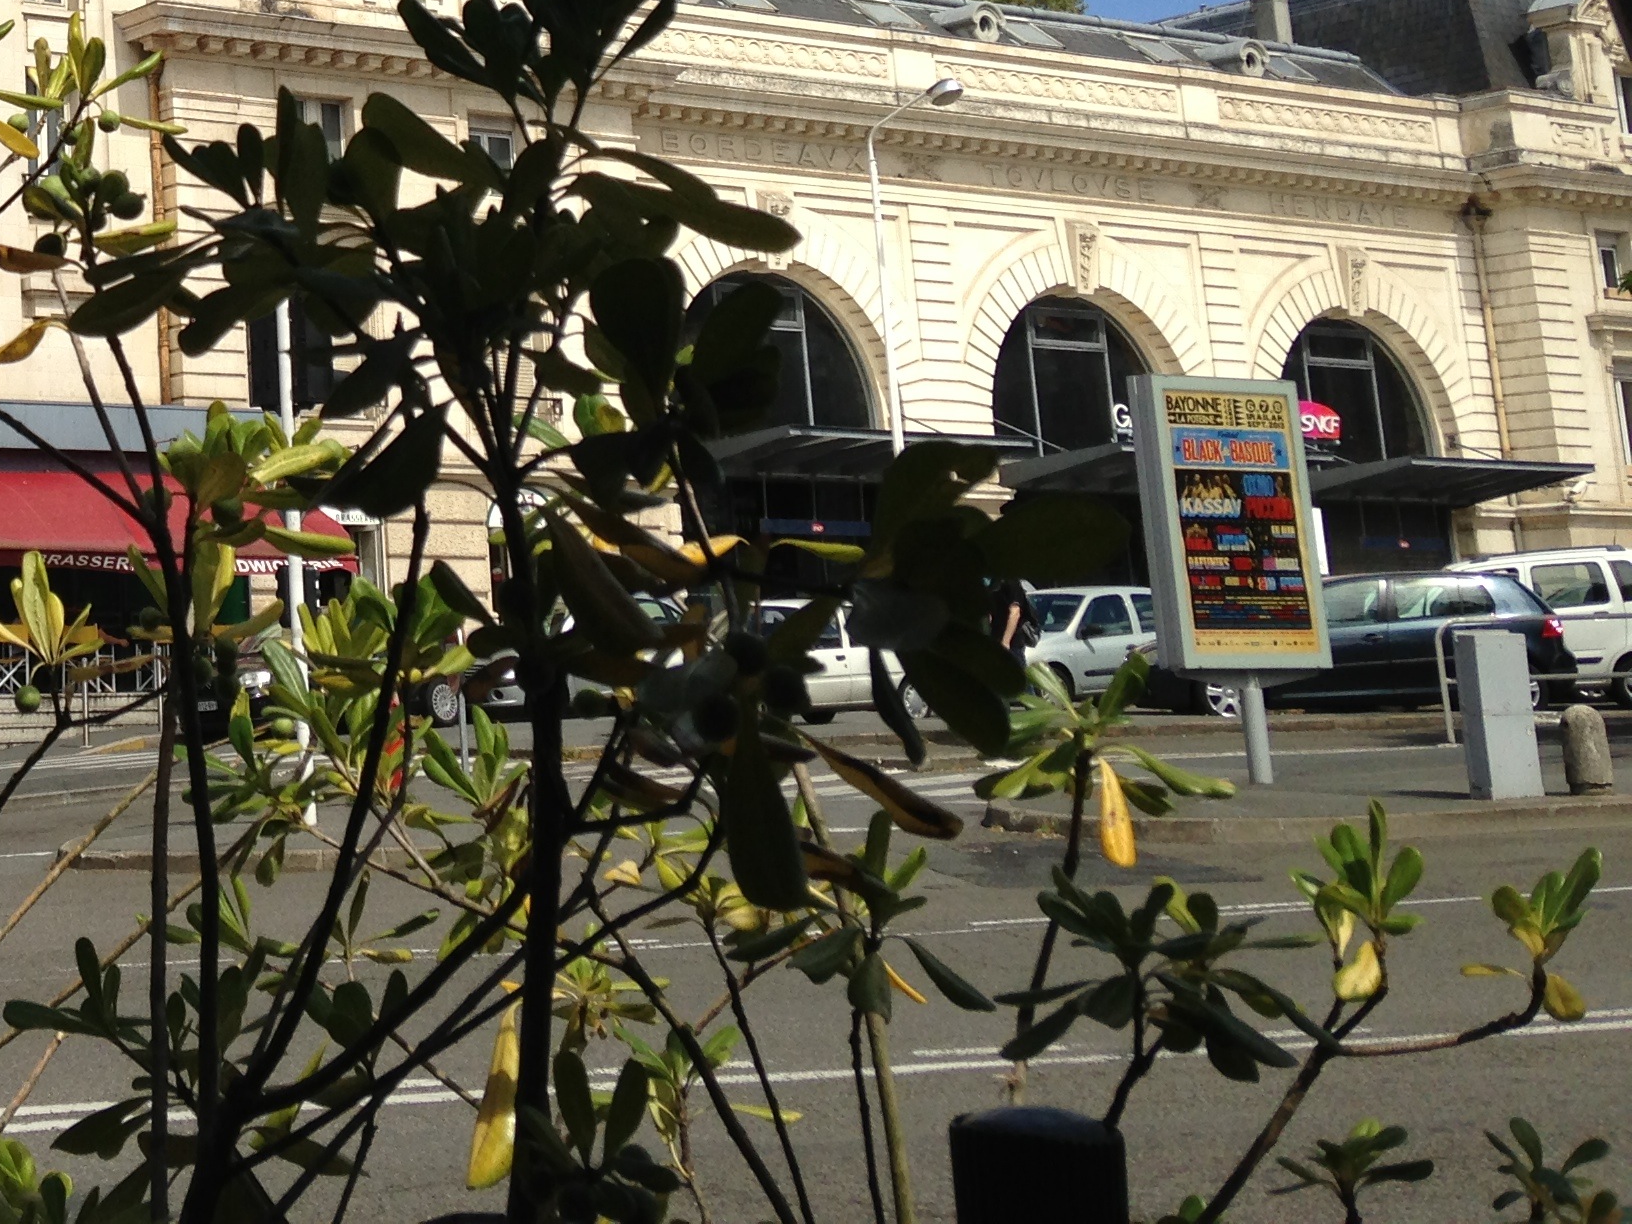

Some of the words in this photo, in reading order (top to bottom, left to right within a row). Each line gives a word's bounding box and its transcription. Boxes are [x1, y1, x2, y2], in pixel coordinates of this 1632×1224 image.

[1166, 395, 1222, 413] BAYONNE
[1301, 414, 1340, 433] SNCF
[1182, 438, 1225, 463] BLACK
[1230, 439, 1276, 465] BASQUE
